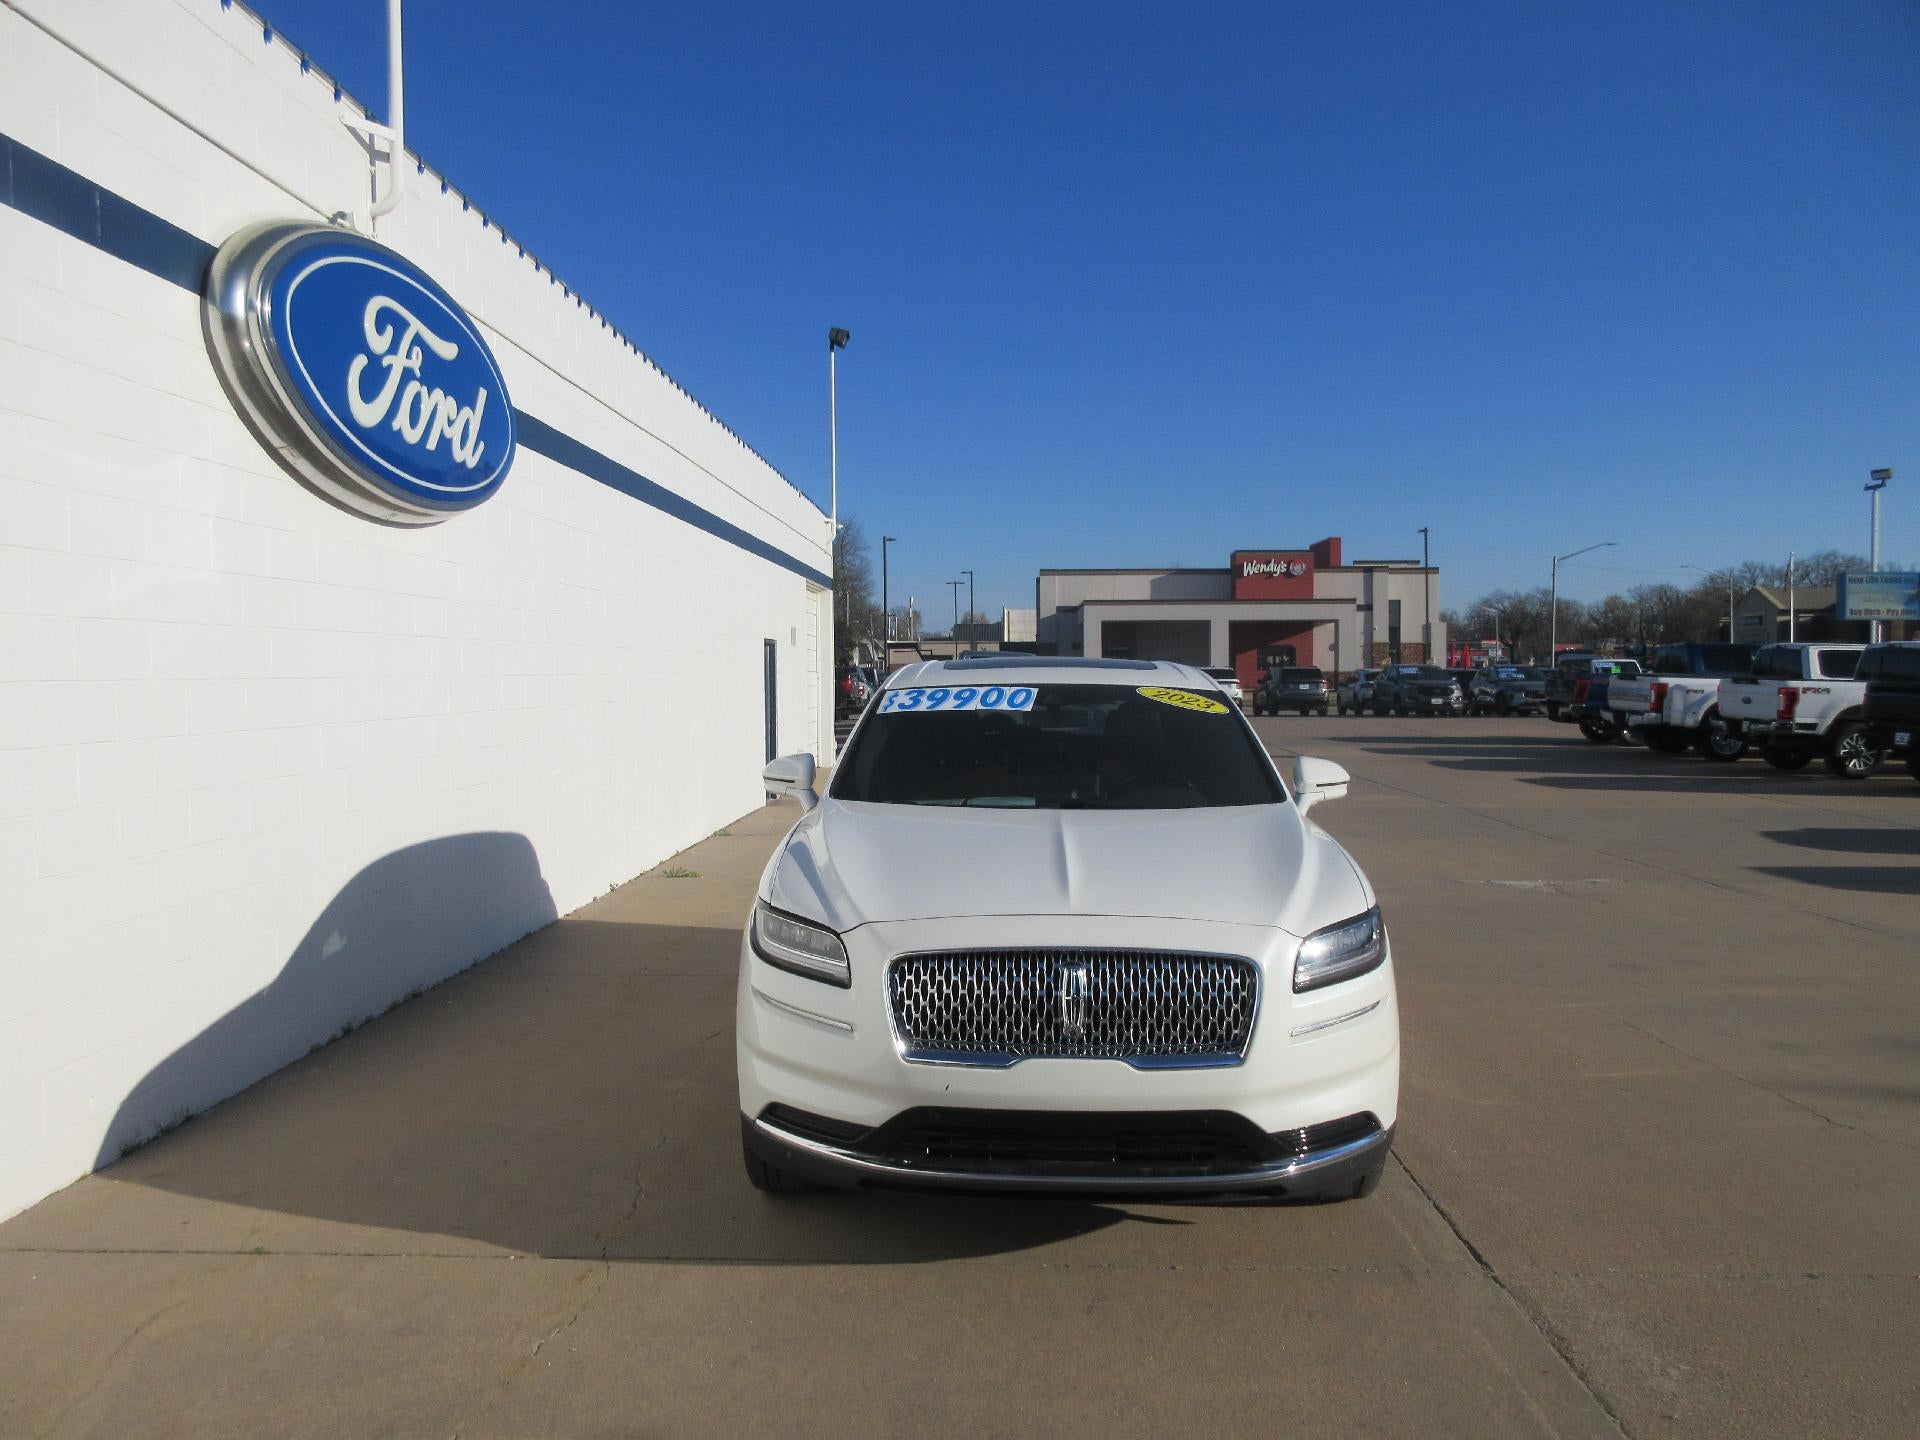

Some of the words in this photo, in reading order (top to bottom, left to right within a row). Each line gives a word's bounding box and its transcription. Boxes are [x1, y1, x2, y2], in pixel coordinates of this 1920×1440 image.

[348, 295, 487, 469] Ford
[1243, 557, 1287, 577] Wendy's
[882, 687, 1034, 712] $39900
[1153, 690, 1216, 709] 2023
